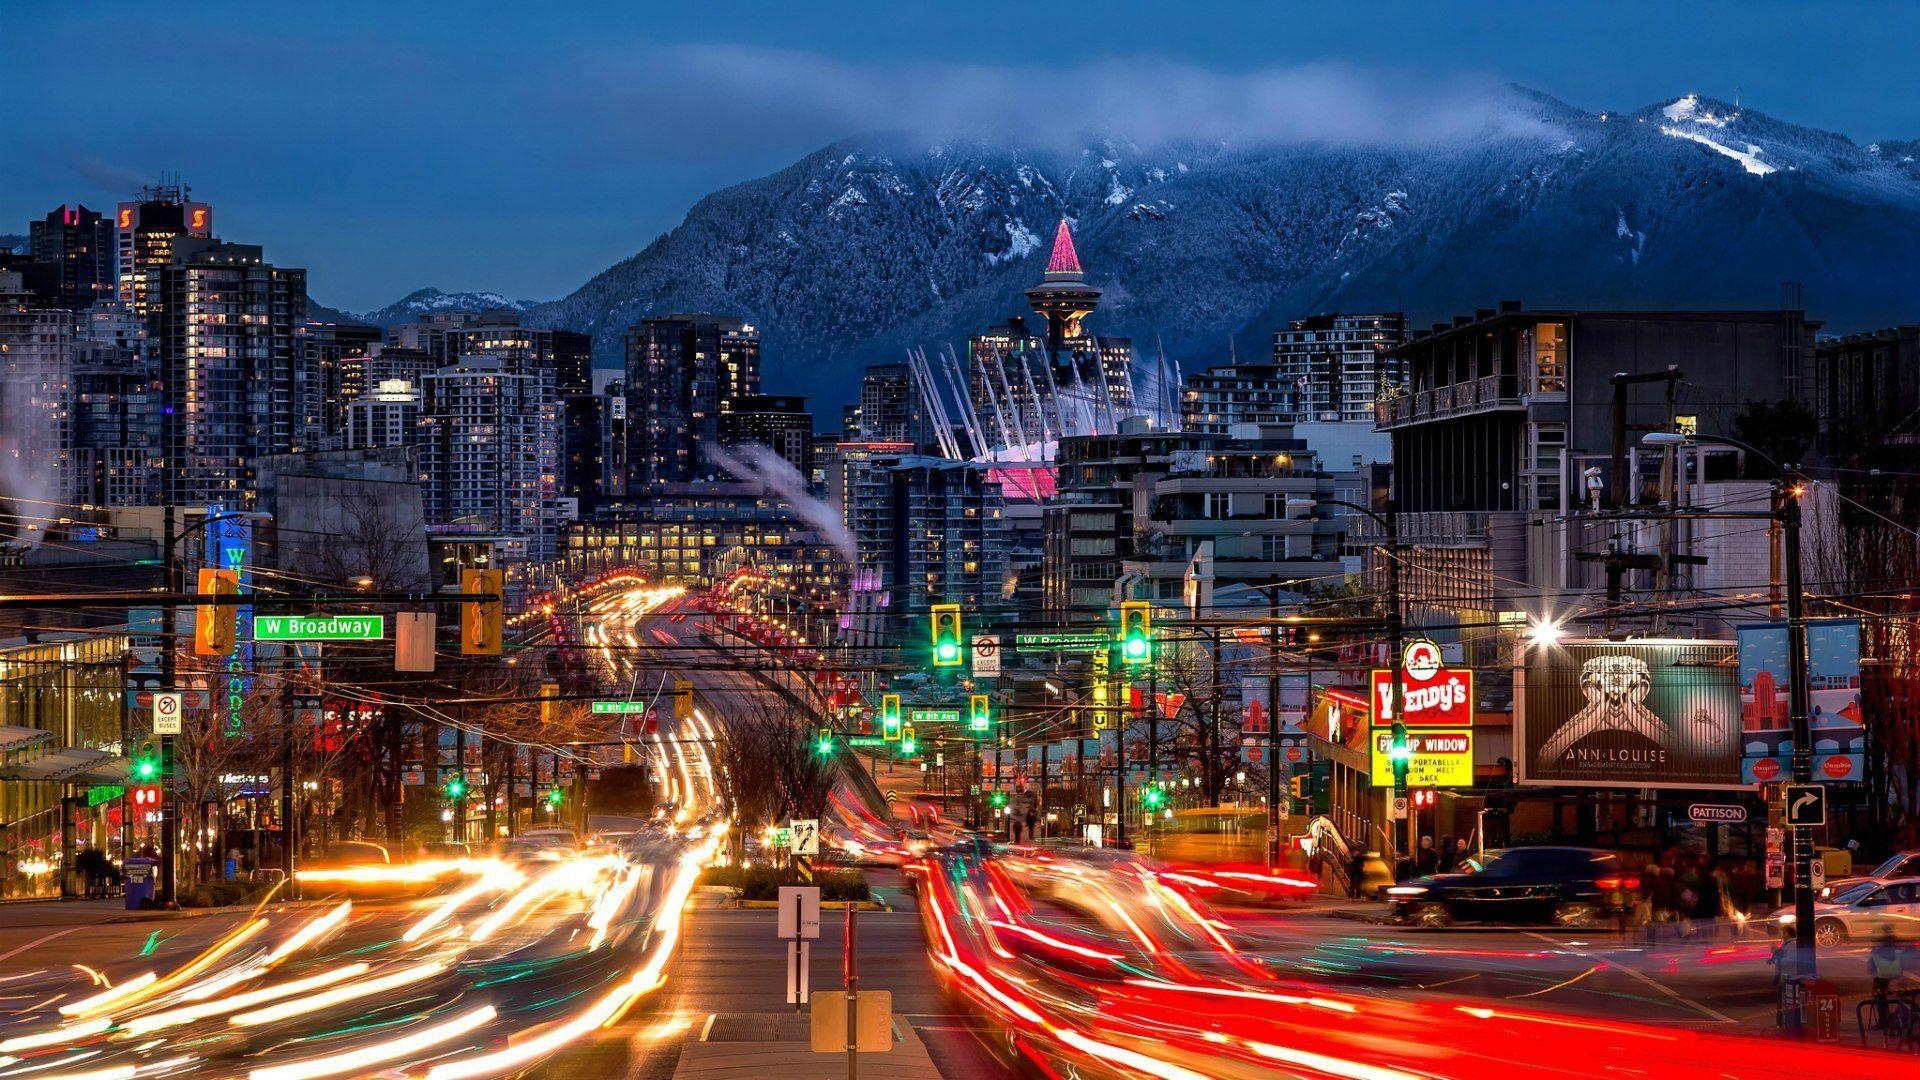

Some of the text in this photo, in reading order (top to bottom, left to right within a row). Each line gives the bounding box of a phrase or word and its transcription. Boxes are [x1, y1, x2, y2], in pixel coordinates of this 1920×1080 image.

[265, 619, 372, 637] W Broadway
[1023, 635, 1103, 649] W Broadway
[926, 712, 939, 720] 8th
[1425, 739, 1467, 752] WINDOW
[1566, 748, 1666, 762] ANN LOUISE
[1693, 807, 1742, 819] PATTISON
[1819, 999, 1834, 1011] 24
